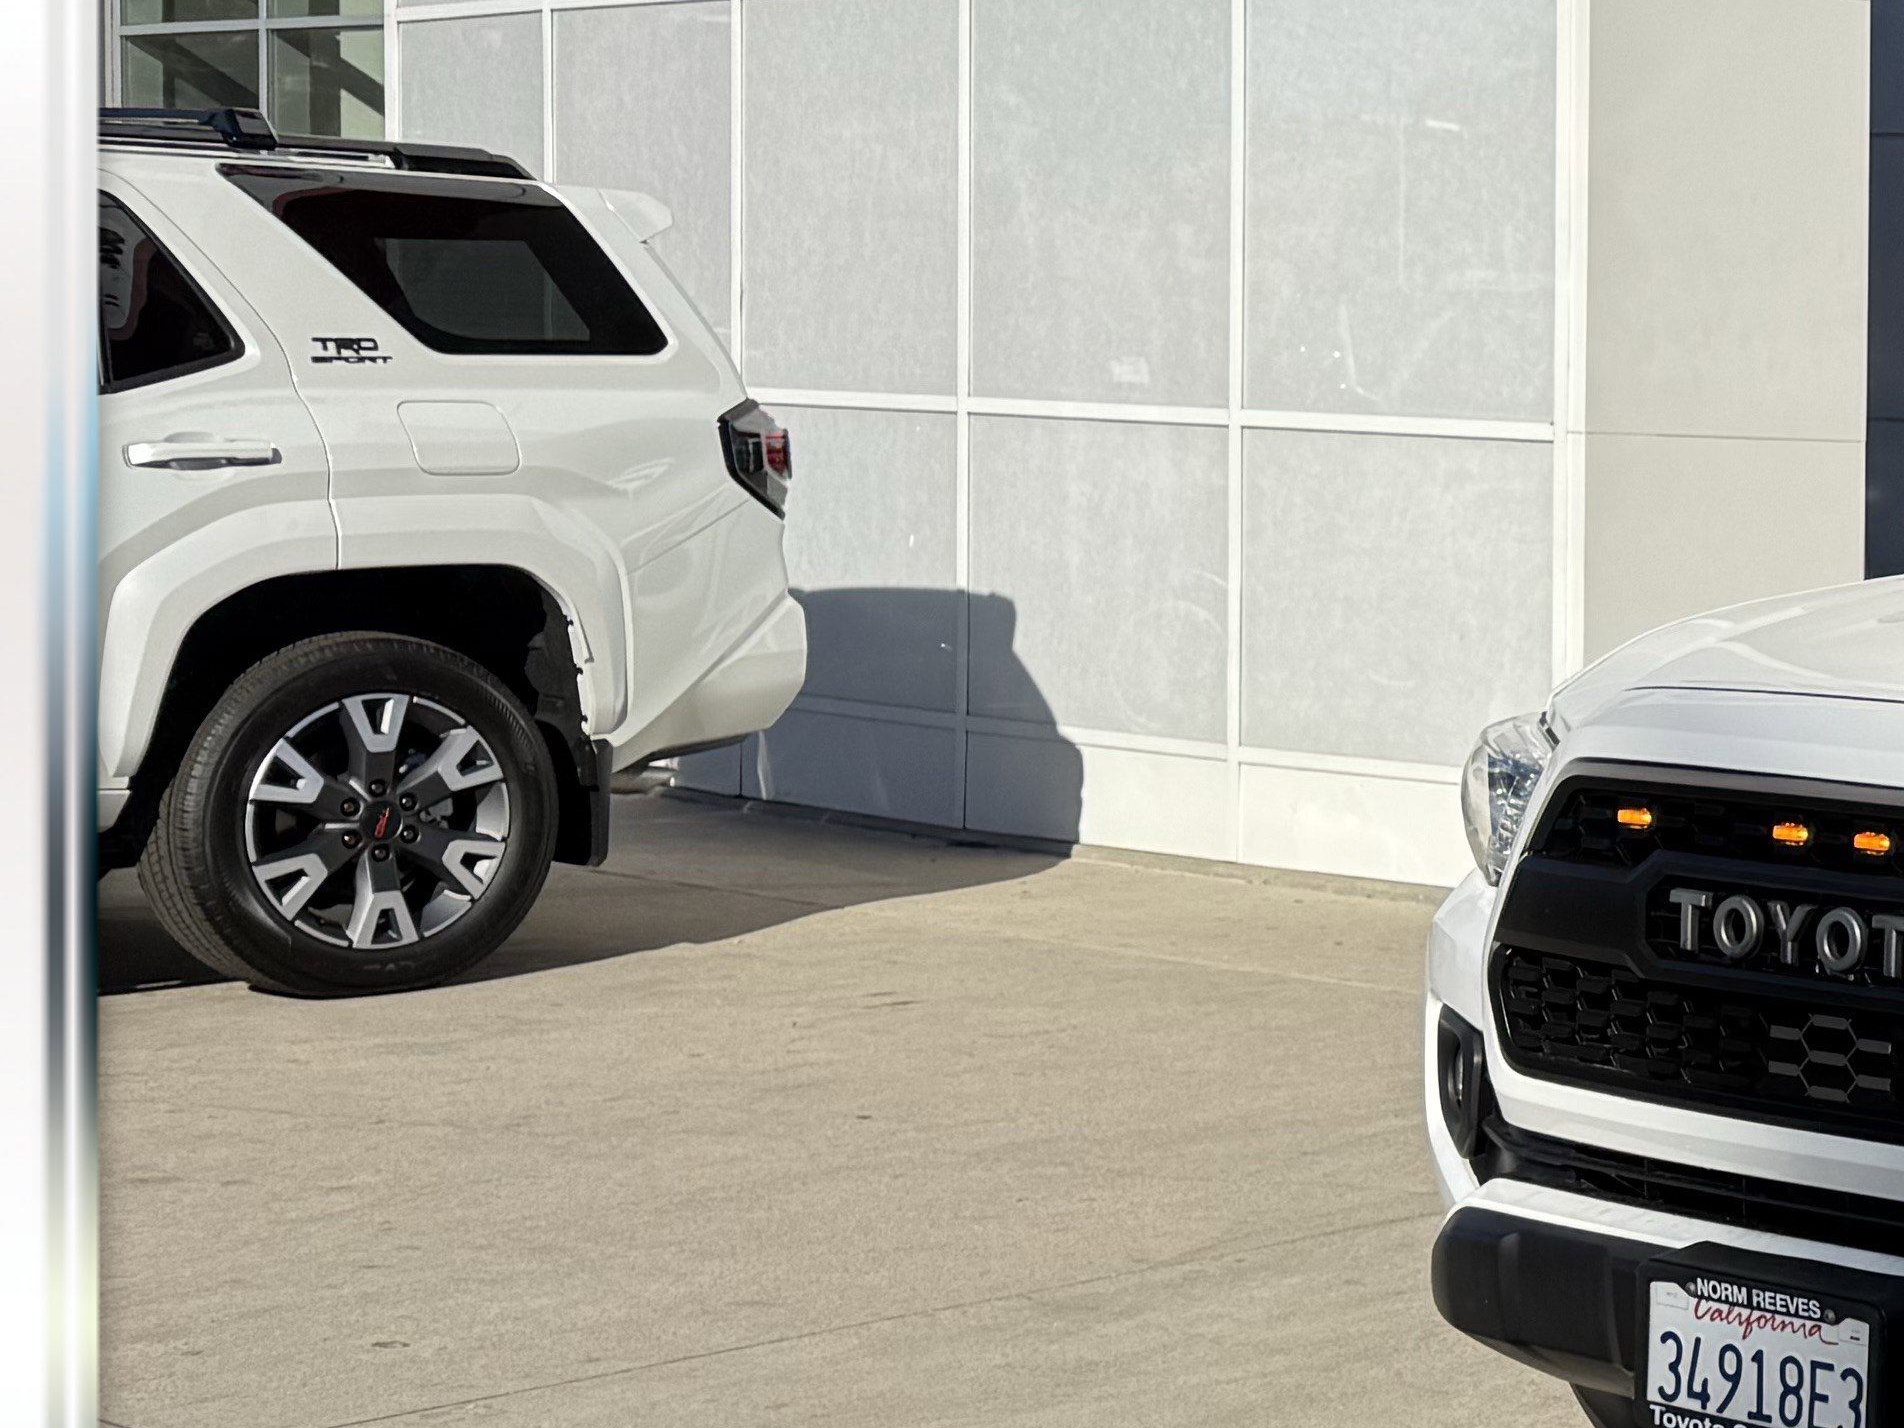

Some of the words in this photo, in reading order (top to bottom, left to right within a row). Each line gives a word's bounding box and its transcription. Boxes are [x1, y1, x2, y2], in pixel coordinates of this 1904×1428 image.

[311, 337, 379, 356] TRD
[1696, 1277, 1748, 1306] NORM
[1752, 1288, 1821, 1320] REEVES
[1694, 1298, 1839, 1345] California
